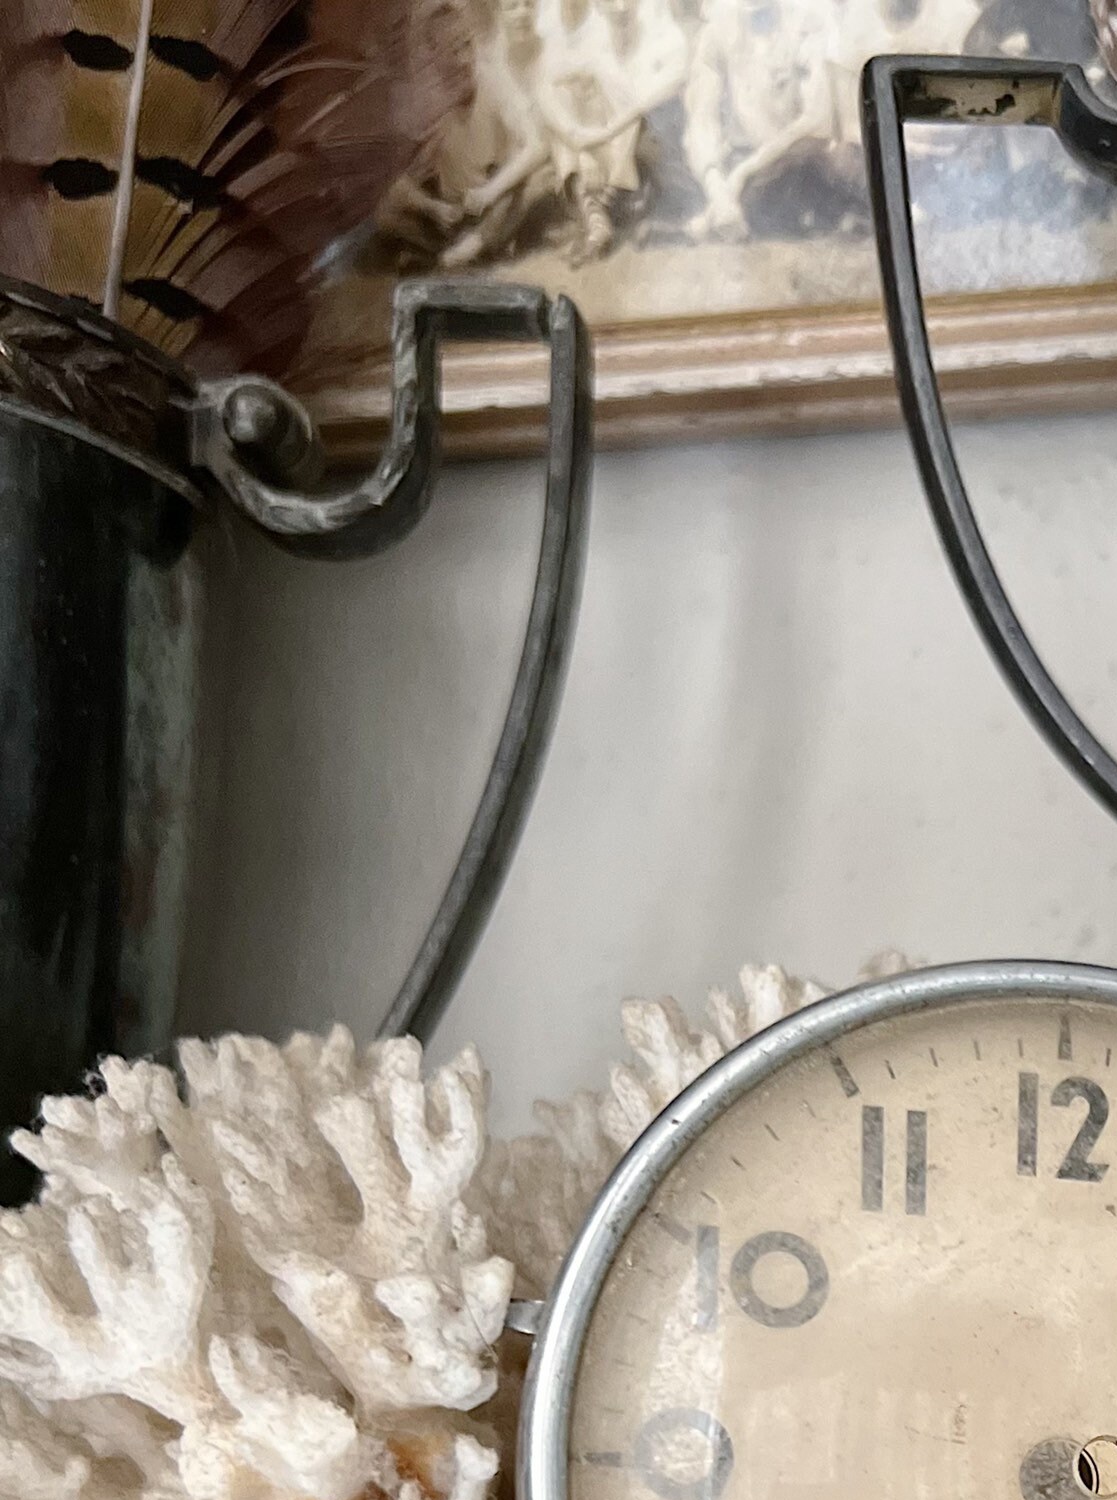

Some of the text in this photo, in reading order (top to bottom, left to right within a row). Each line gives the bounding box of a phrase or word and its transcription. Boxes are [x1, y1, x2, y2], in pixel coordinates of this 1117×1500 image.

[860, 1105, 929, 1217] 11
[1015, 1072, 1111, 1181] 12
[696, 1226, 830, 1331] 10
